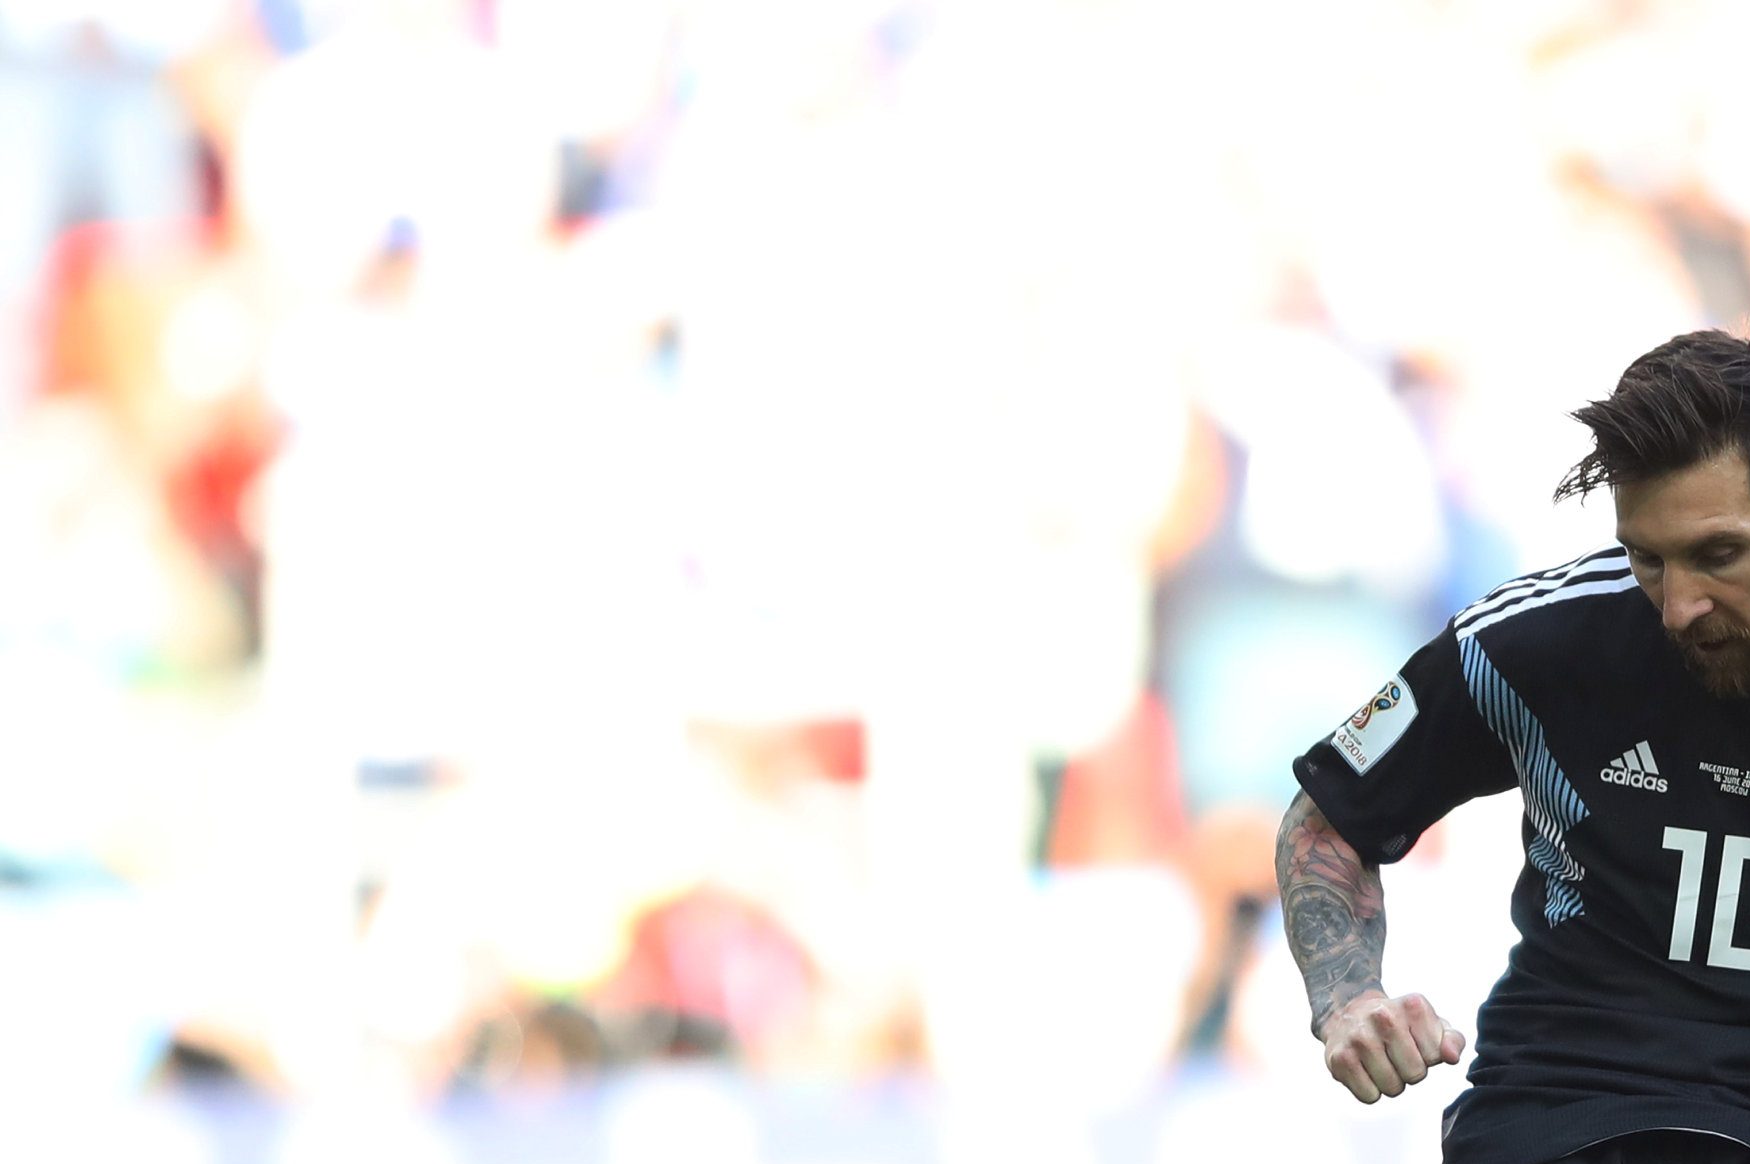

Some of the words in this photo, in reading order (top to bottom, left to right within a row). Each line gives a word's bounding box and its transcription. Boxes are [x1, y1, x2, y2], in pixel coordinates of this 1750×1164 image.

[1344, 740, 1367, 766] 2018
[1600, 768, 1668, 793] adidas
[1713, 773, 1721, 783] 16
[1722, 775, 1741, 786] JUNE
[1720, 783, 1749, 797] MOSCOW
